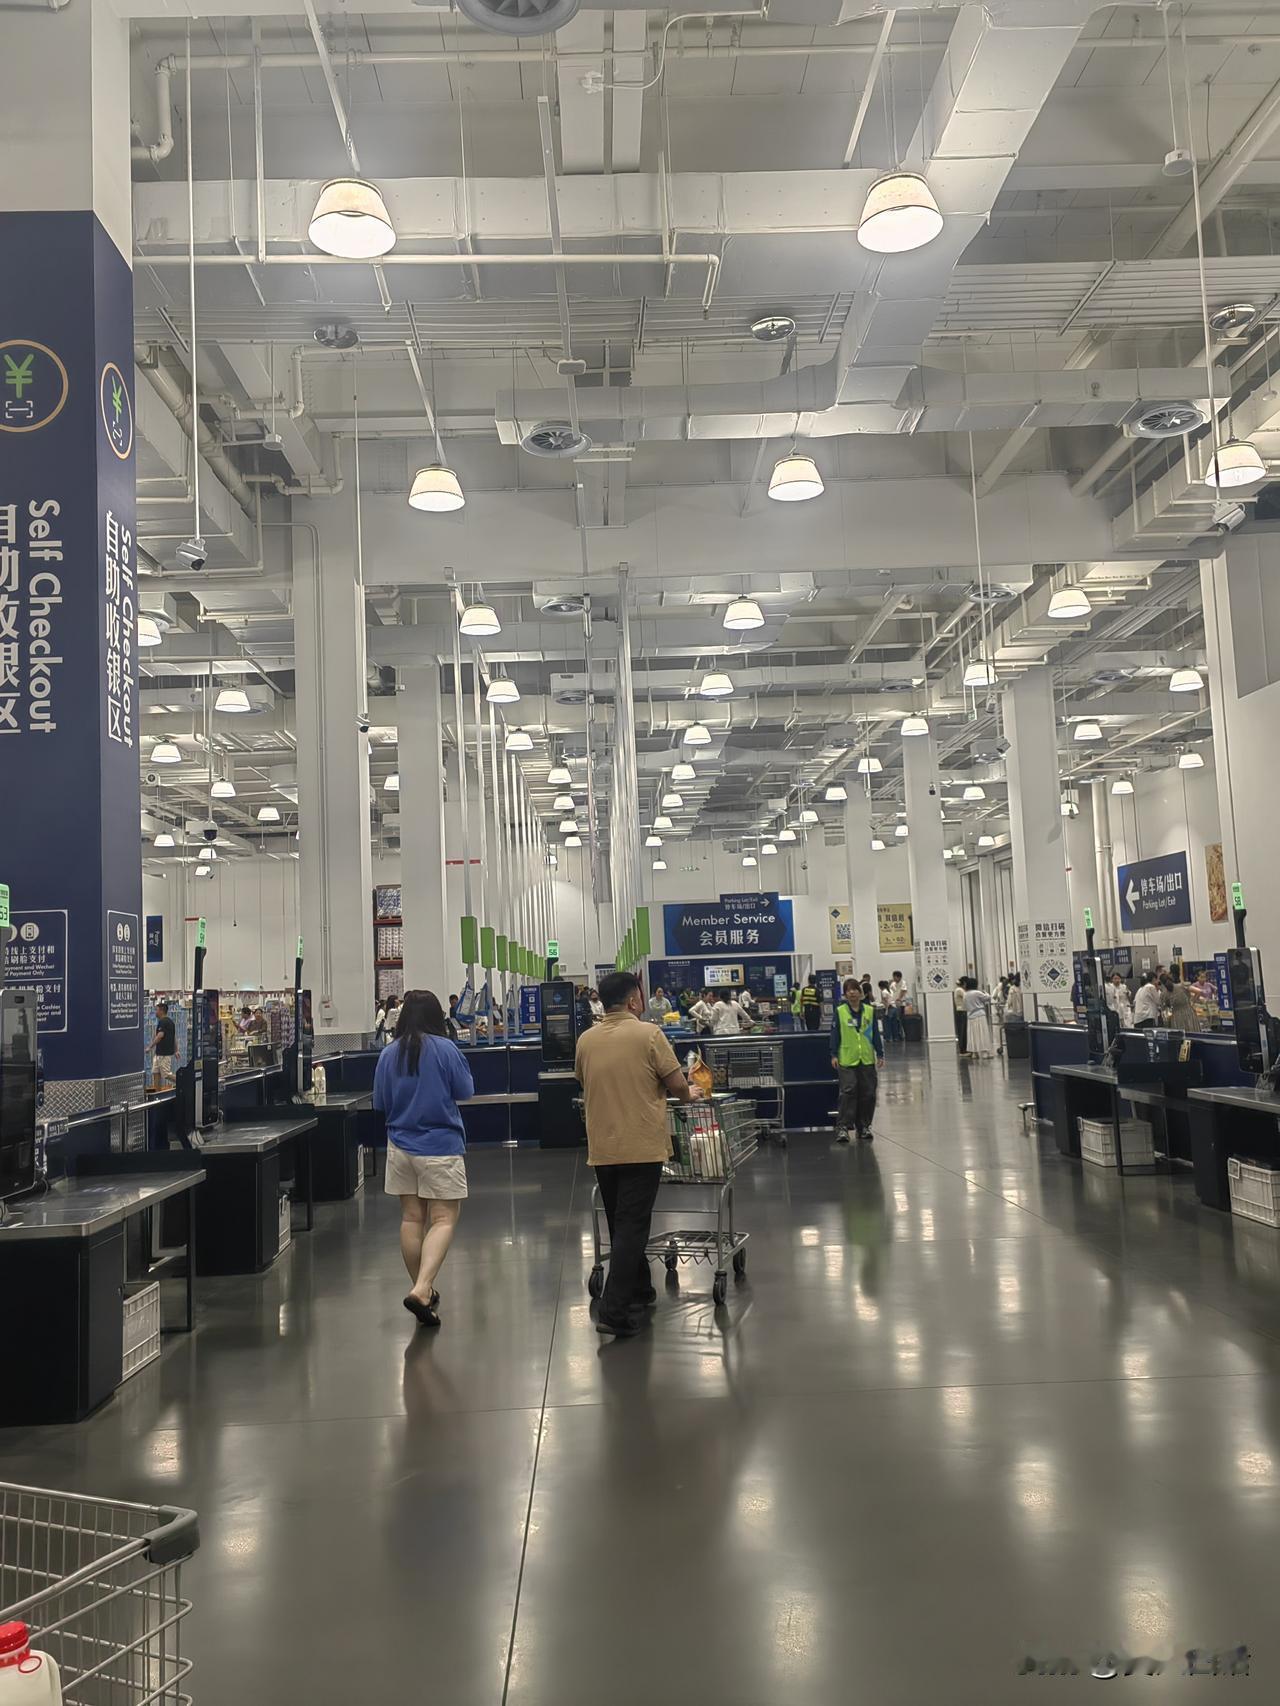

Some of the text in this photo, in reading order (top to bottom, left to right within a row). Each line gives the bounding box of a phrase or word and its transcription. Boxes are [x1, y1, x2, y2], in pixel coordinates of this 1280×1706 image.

[29, 499, 64, 733] Self Checkout
[105, 510, 122, 743] 自助收银区
[121, 525, 134, 749] Self Checkout
[682, 913, 776, 927] Member Service
[699, 929, 760, 946] 会员服务
[1141, 872, 1183, 897] 停车场/出口
